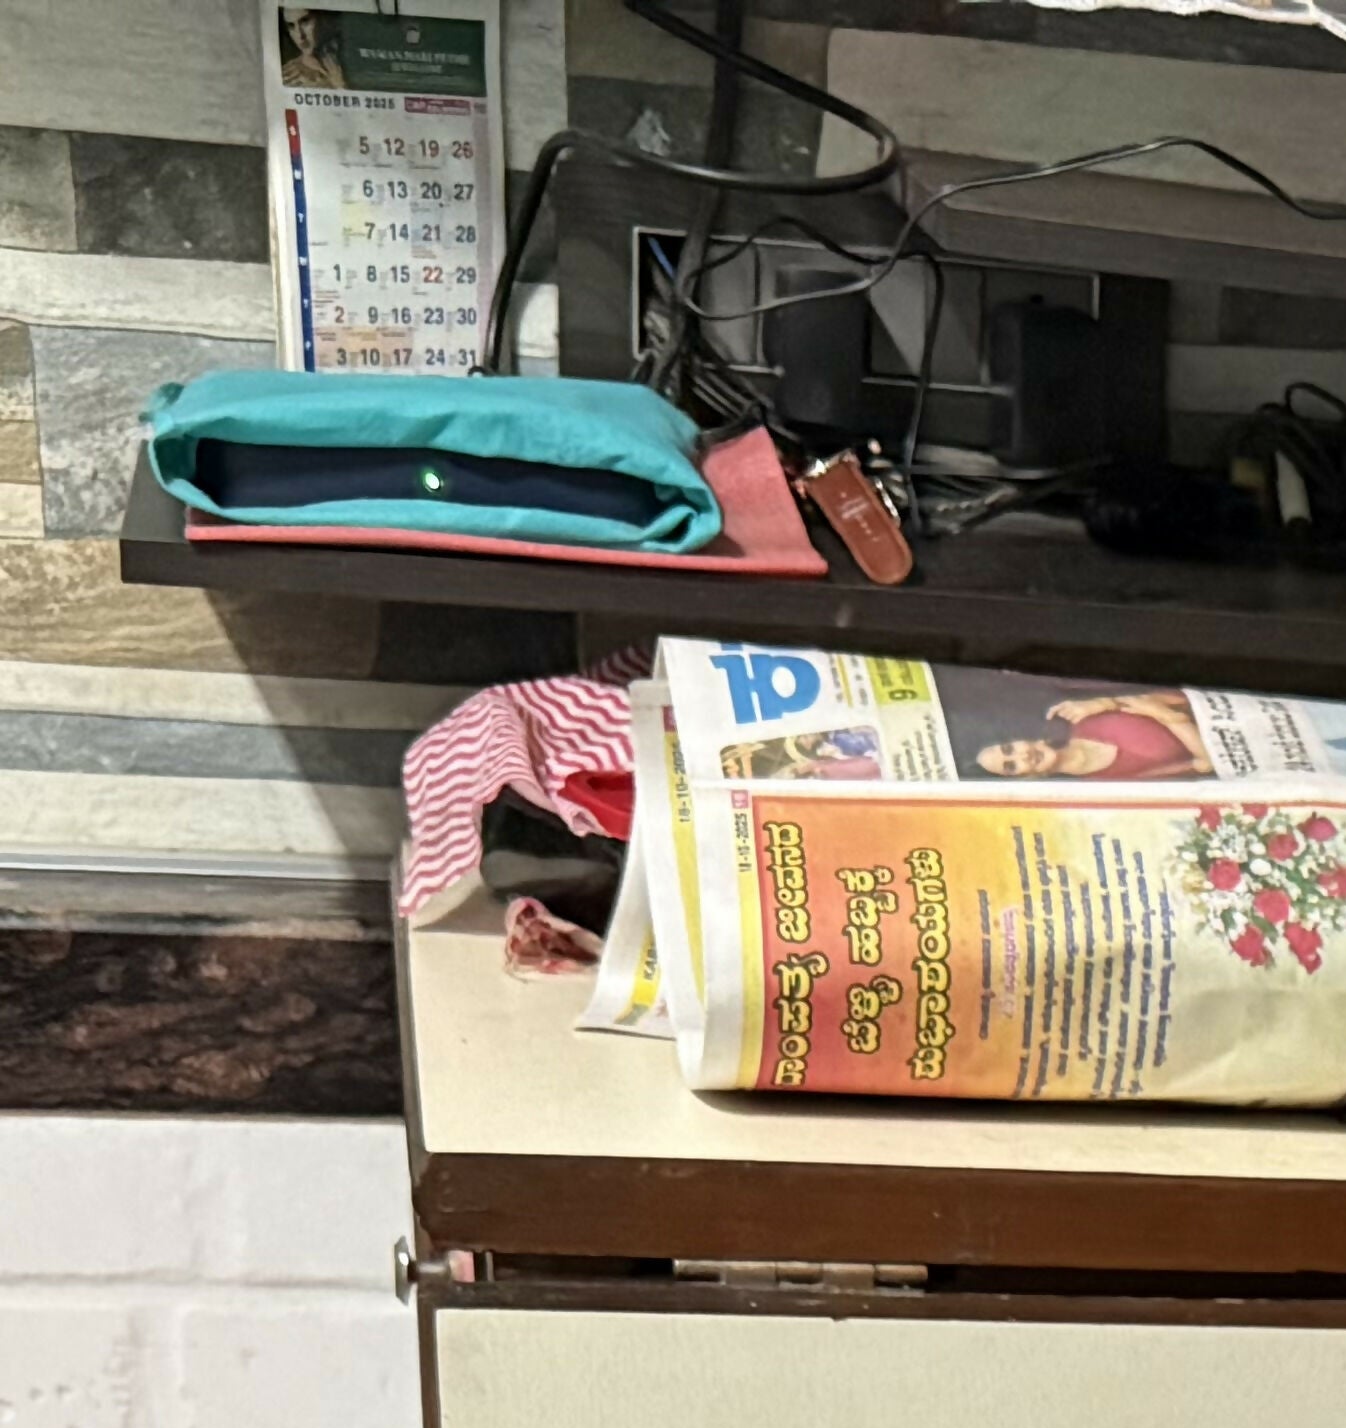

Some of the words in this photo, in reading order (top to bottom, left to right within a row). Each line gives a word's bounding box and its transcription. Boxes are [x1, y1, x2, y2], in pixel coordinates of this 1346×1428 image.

[294, 93, 361, 109] OCTOBER
[359, 136, 370, 156] 5
[384, 137, 406, 157] 12
[419, 139, 440, 158] 19
[452, 140, 475, 159] 26
[362, 180, 374, 199] 6
[387, 180, 409, 200] 13
[420, 181, 443, 201] 20
[453, 183, 475, 202] 27
[363, 222, 376, 241] 7
[389, 223, 410, 242] 14
[421, 224, 442, 242] 21
[455, 225, 477, 244] 28
[333, 264, 343, 282] 1
[366, 265, 378, 284] 8
[390, 265, 411, 284] 15
[422, 266, 444, 285] 22
[456, 267, 478, 285] 29
[333, 306, 346, 324] 2
[367, 306, 379, 325] 9
[391, 307, 413, 326] 16
[423, 307, 446, 325] 23
[456, 307, 478, 326] 30
[336, 348, 348, 367] 3
[360, 349, 381, 367] 10
[393, 348, 414, 367] 17
[426, 348, 446, 367] 24
[458, 349, 478, 368] 31
